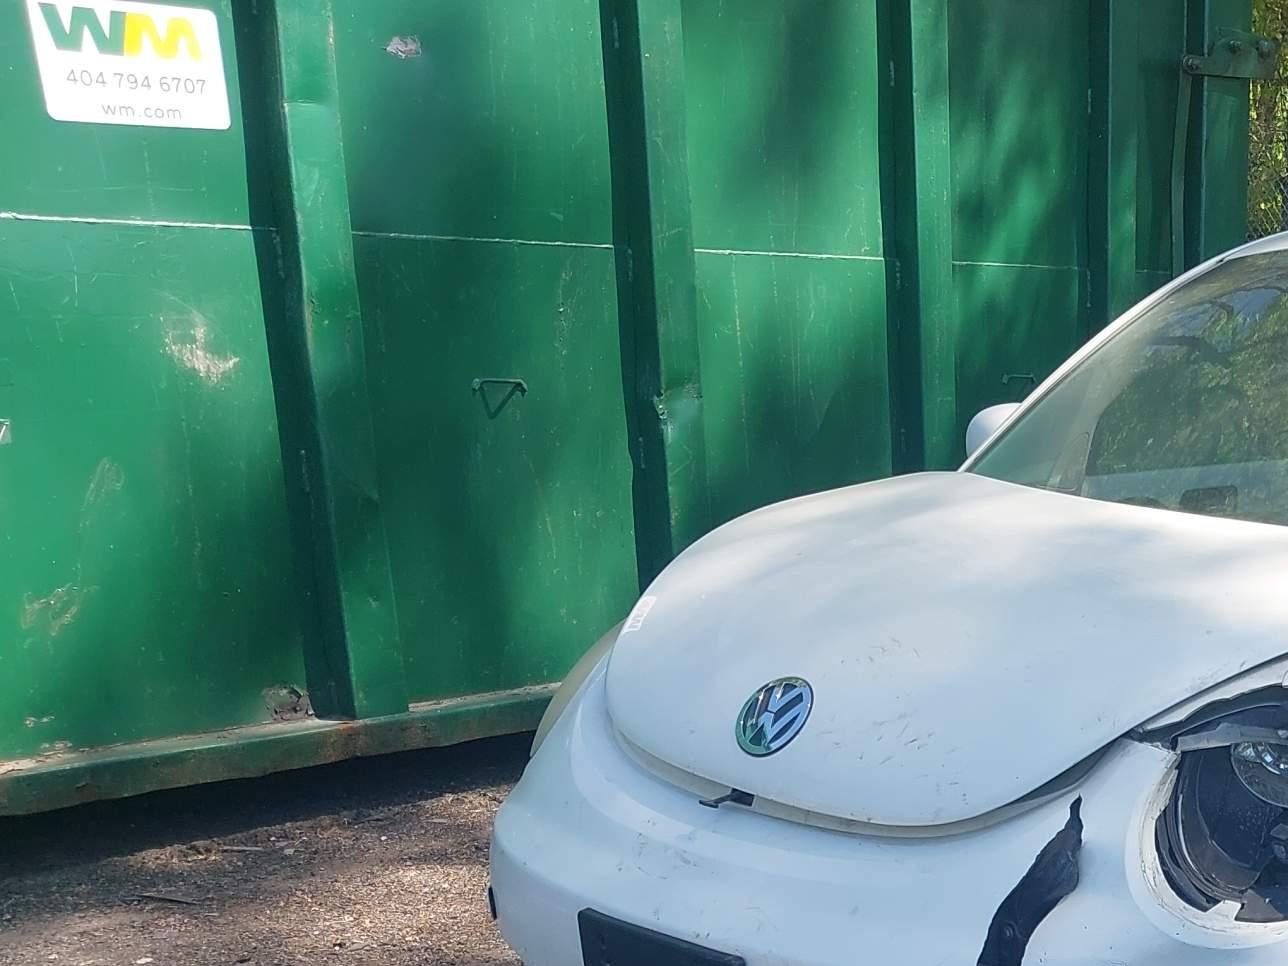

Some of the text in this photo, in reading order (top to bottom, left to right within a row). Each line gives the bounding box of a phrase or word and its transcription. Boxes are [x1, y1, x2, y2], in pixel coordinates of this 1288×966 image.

[38, 1, 202, 62] WM
[66, 68, 207, 95] 404 794 6707
[101, 102, 182, 121] wm.com
[735, 676, 815, 758] VW
